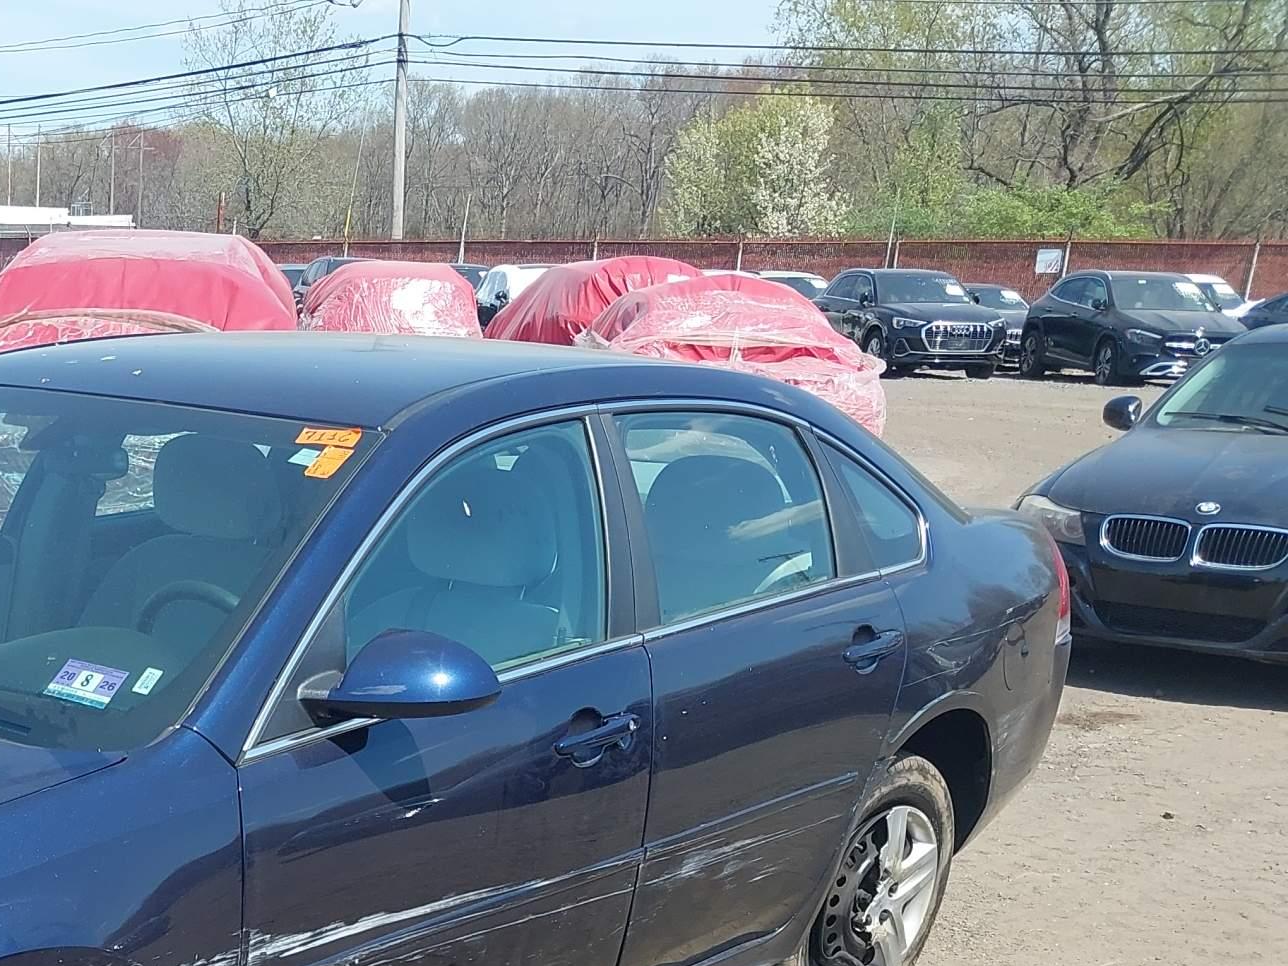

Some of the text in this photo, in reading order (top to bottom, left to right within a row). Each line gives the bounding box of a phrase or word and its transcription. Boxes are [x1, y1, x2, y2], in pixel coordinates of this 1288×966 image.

[60, 670, 117, 691] 20 8 26
